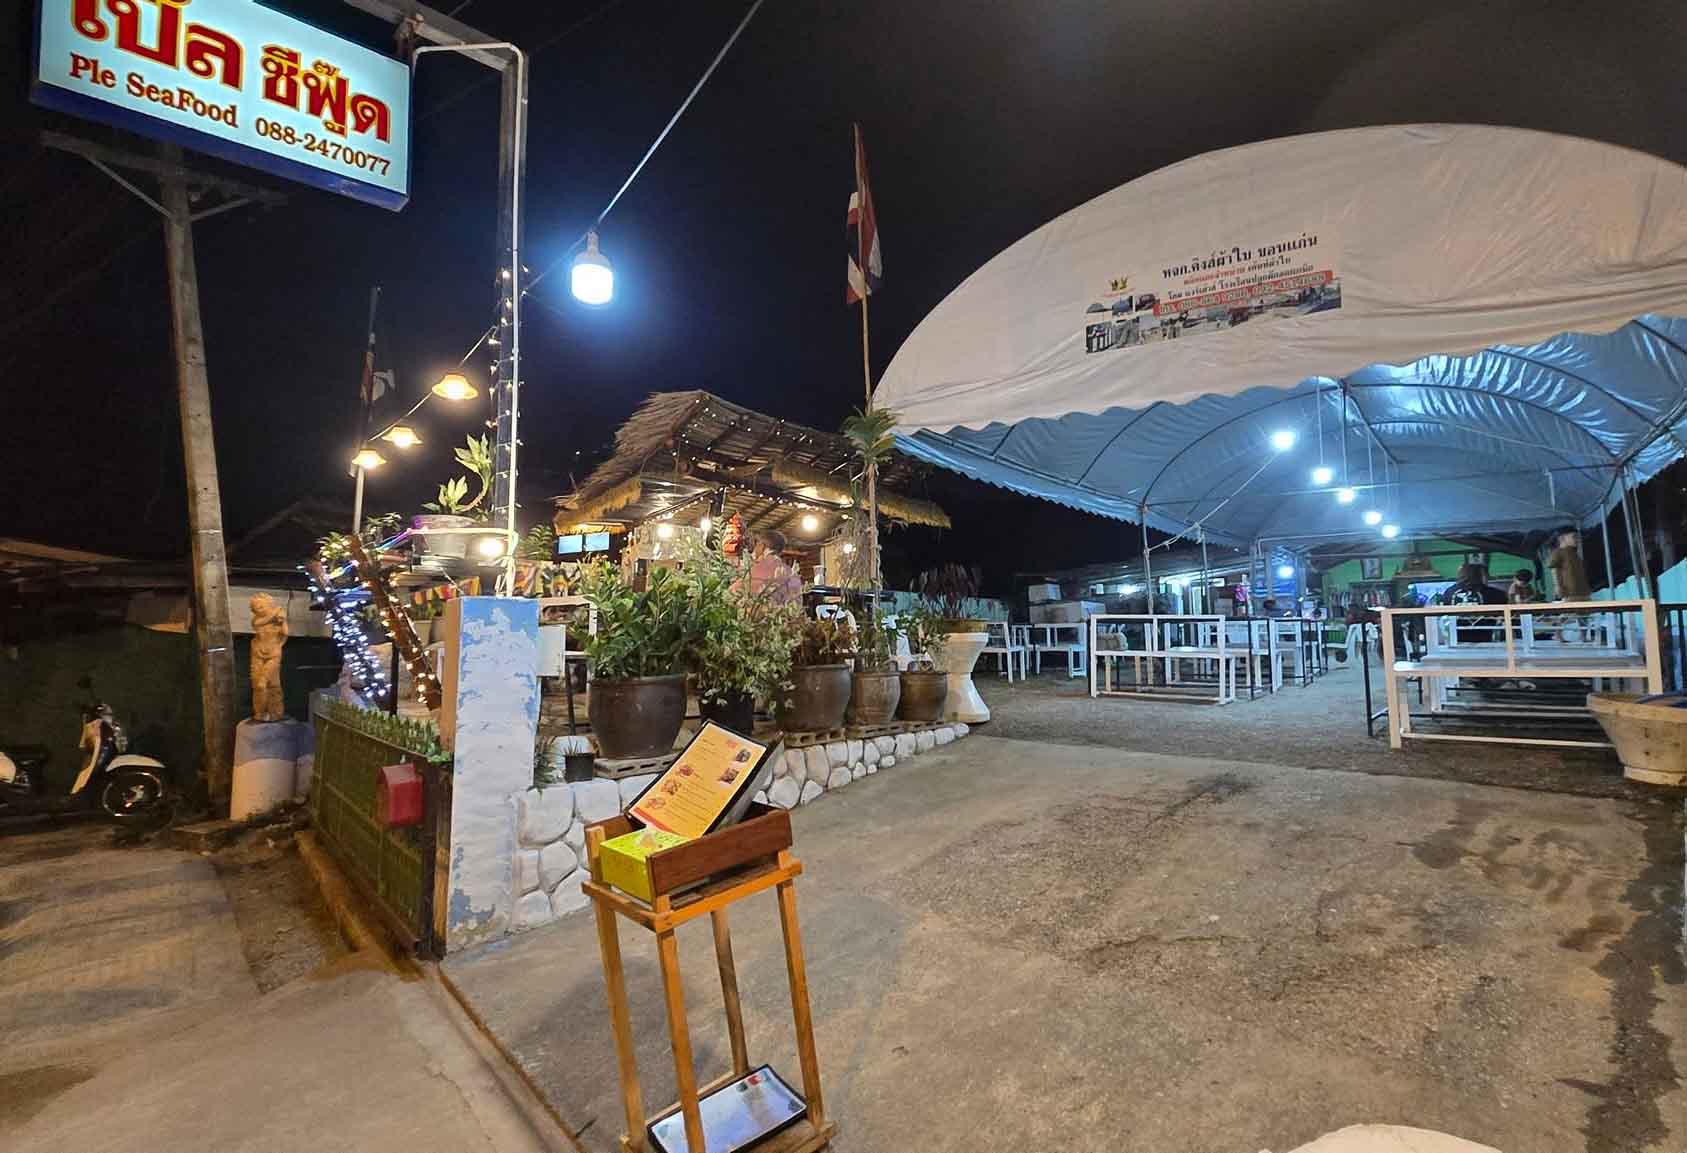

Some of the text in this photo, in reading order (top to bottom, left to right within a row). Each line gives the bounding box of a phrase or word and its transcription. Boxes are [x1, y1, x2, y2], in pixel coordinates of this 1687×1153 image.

[70, 52, 239, 129] Ple SeaFood
[255, 118, 391, 176] 088-2470077
[1258, 233, 1318, 259] ขอนแก่น
